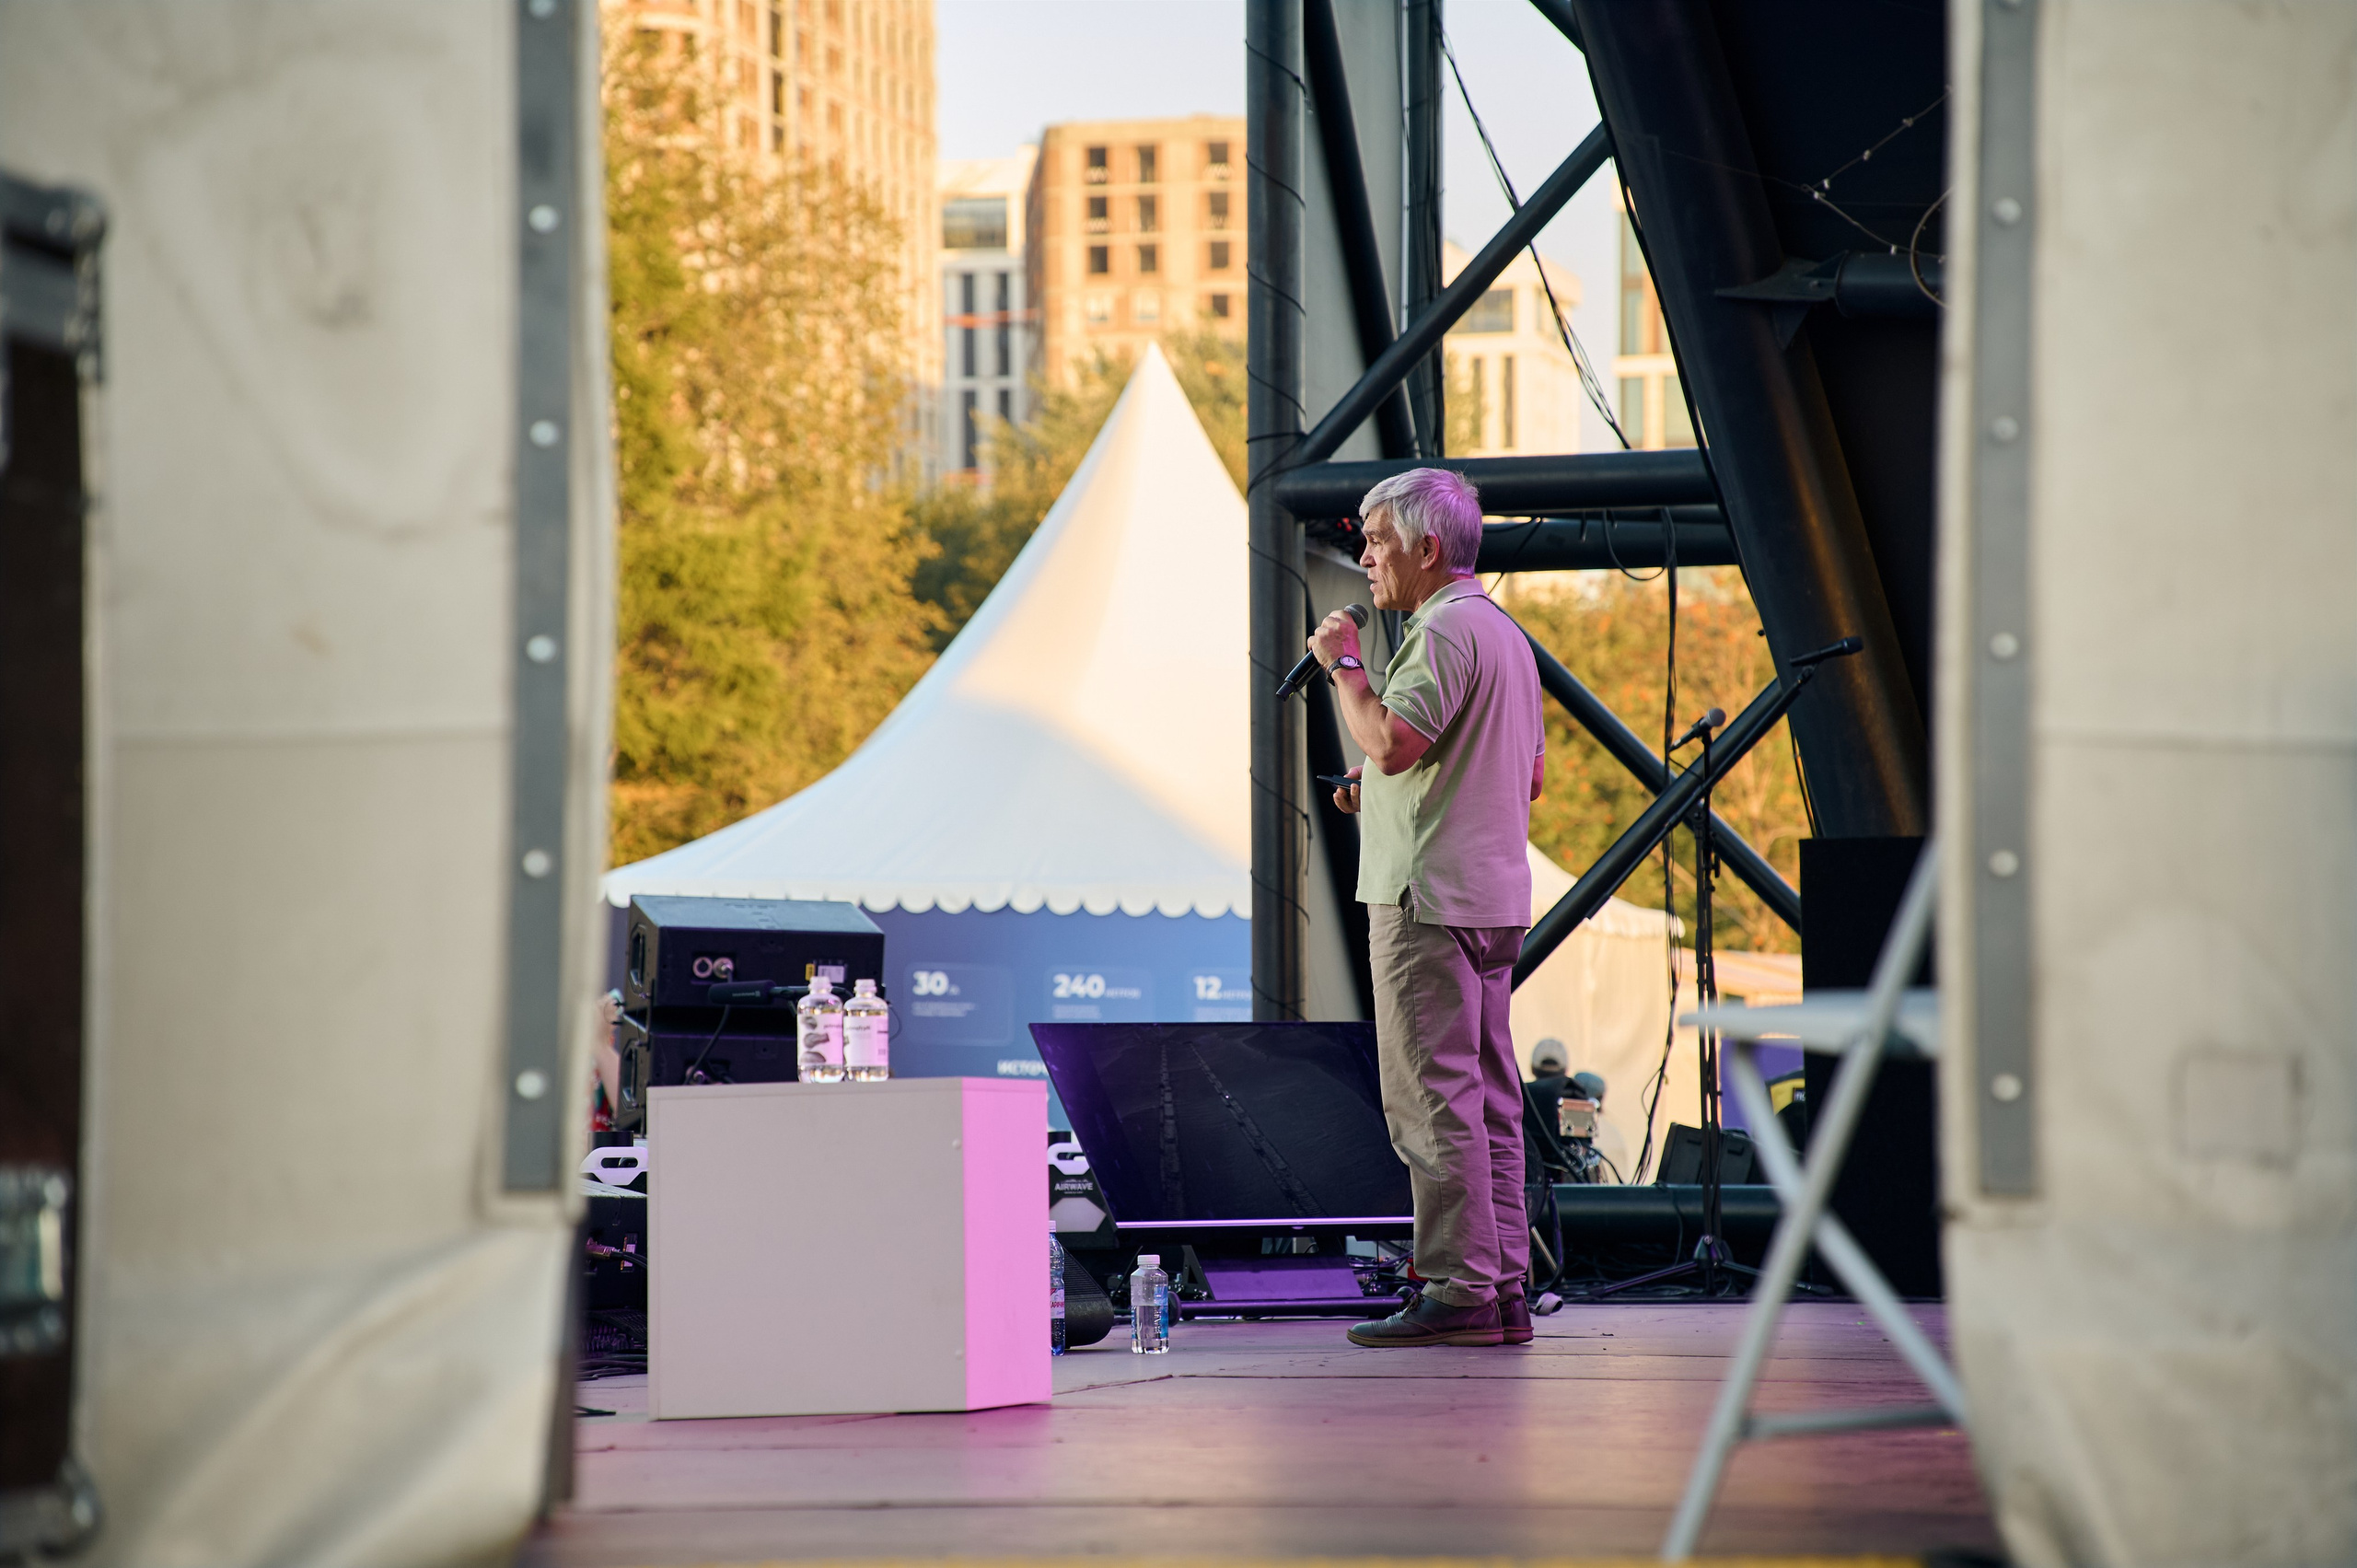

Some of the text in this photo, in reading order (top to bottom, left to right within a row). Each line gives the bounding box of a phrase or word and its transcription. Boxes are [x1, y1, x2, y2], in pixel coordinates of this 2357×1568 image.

[911, 970, 949, 995] 30
[1052, 973, 1105, 998] 240
[1193, 975, 1222, 1000] 12
[1054, 1182, 1094, 1191] AIRWAVE
